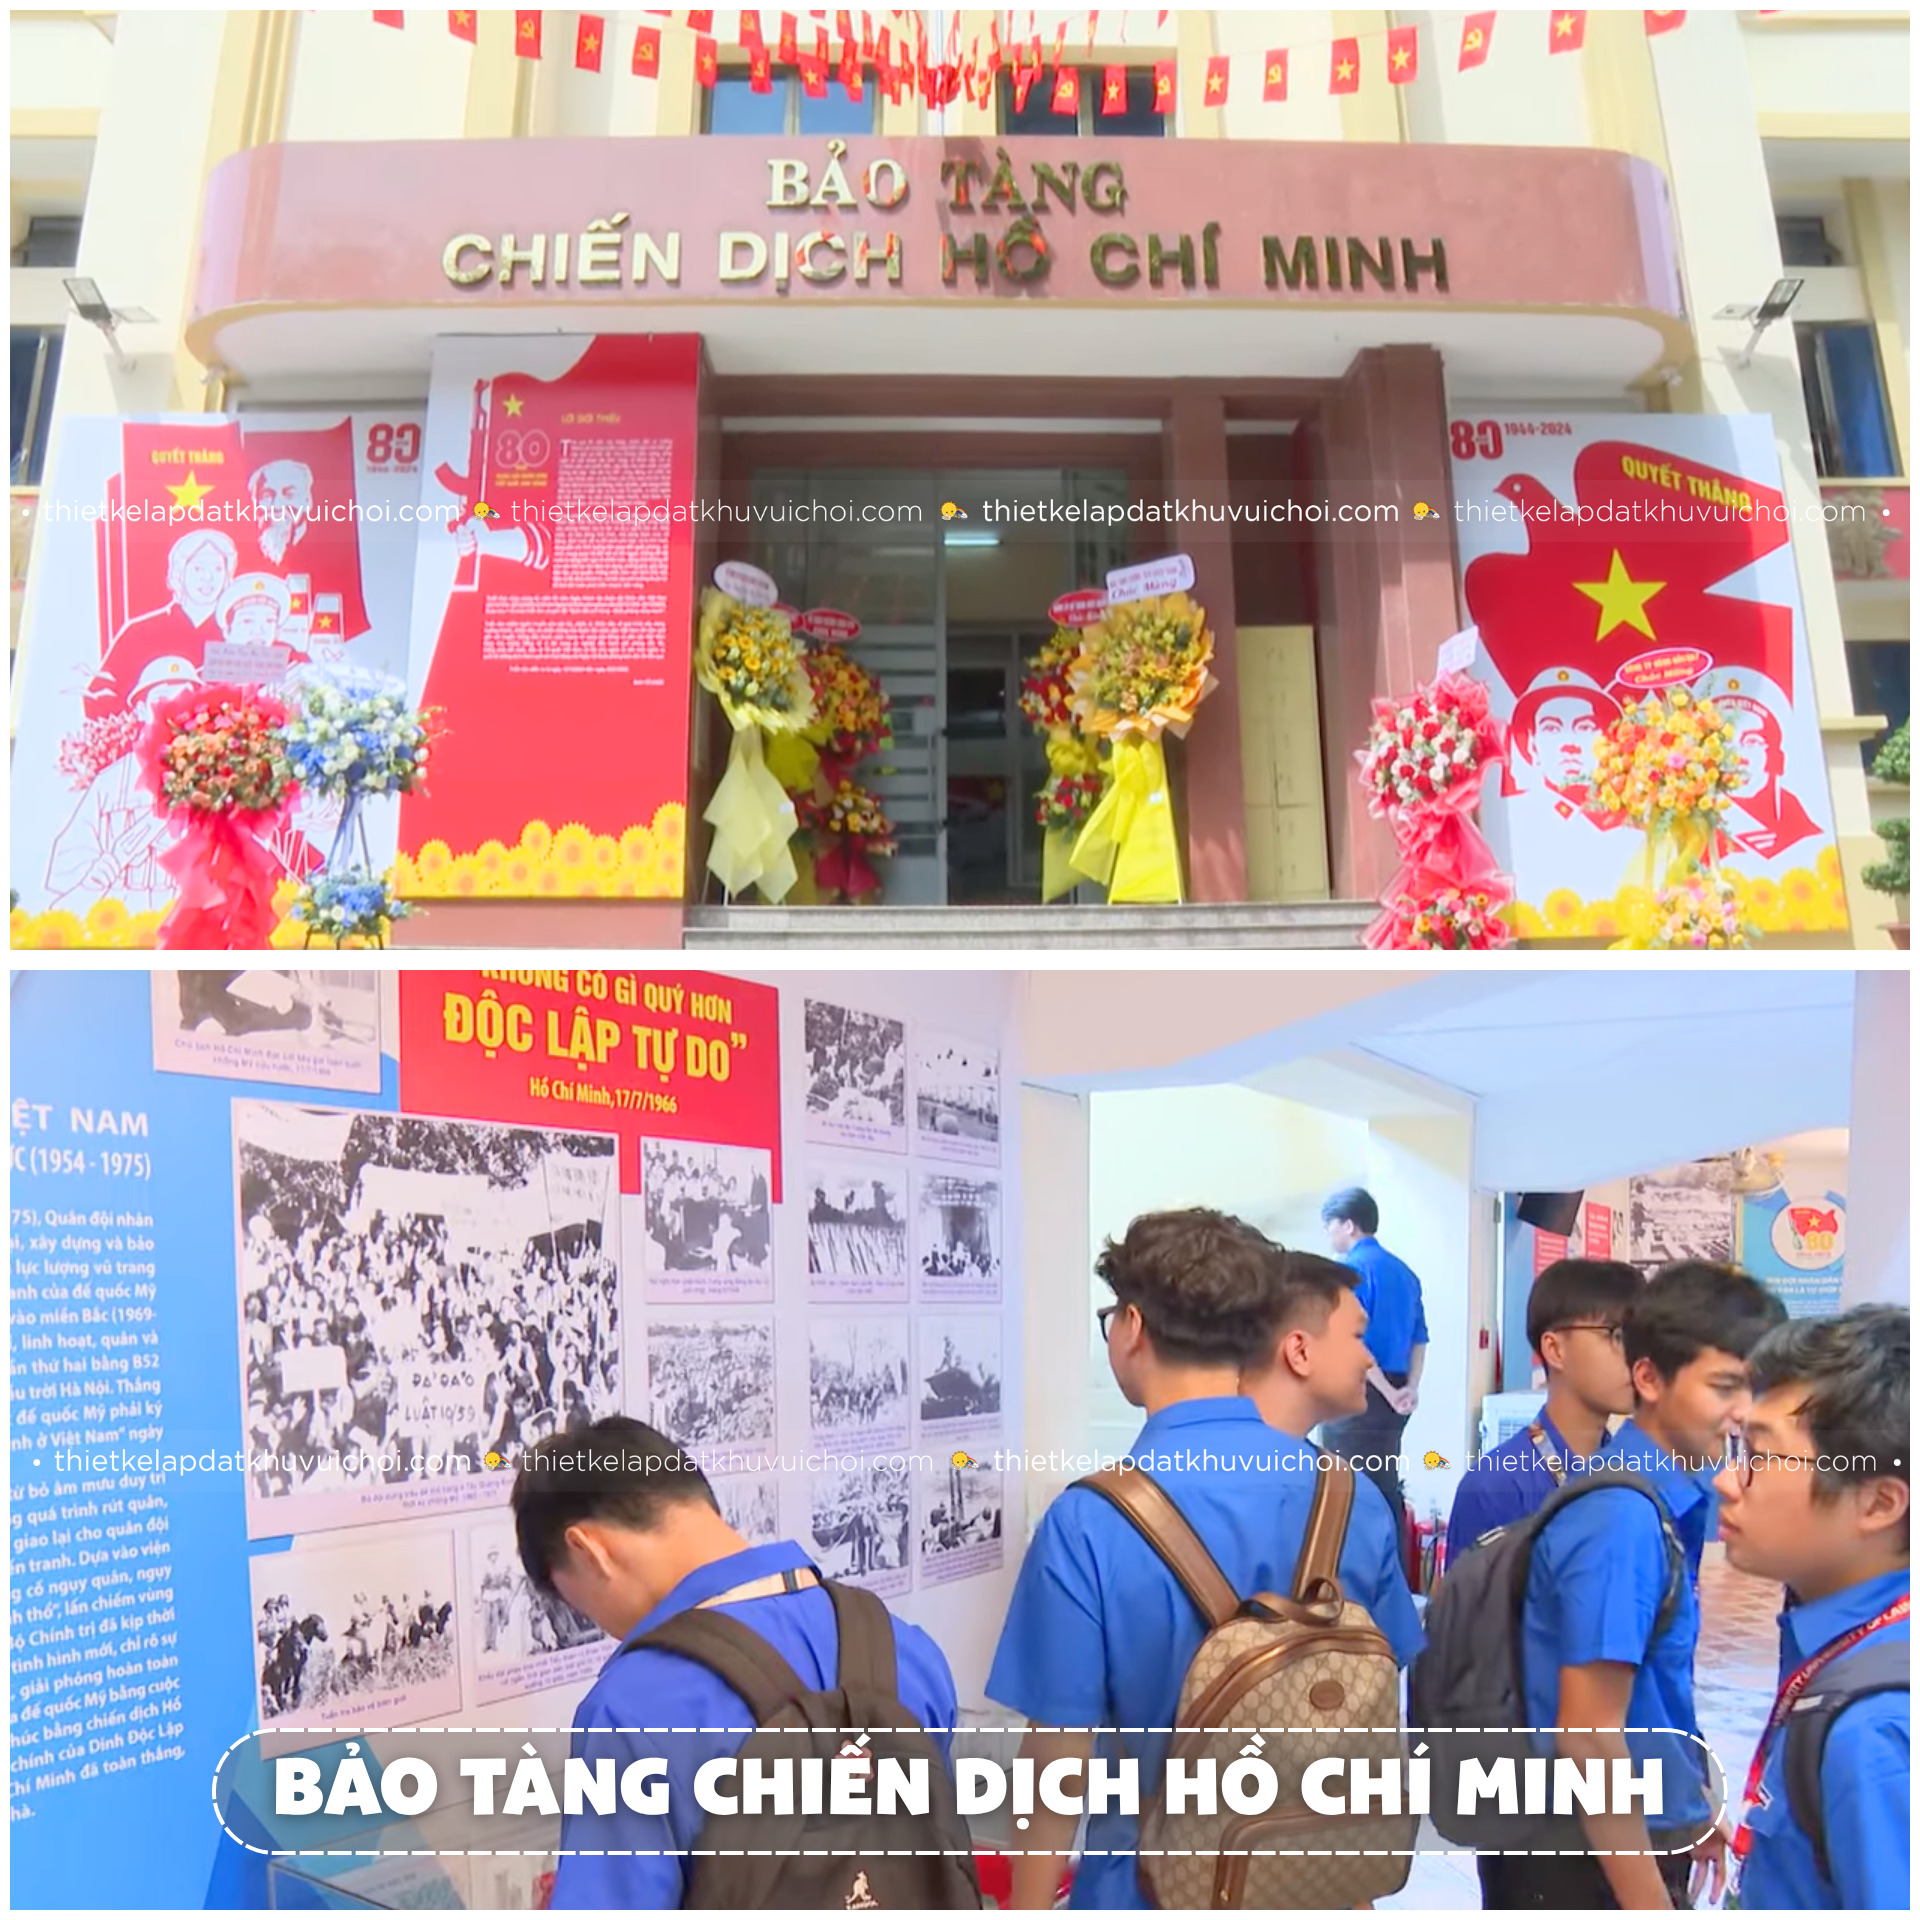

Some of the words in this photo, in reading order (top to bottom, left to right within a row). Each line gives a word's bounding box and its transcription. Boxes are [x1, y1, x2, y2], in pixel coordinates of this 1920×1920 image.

[766, 138, 909, 208] BẢO
[940, 146, 1129, 216] TÀNG
[442, 212, 680, 285] CHIẾN
[719, 231, 901, 293] DỊCH
[940, 213, 1052, 286] HỒ
[1090, 222, 1222, 288] CHÍ
[1261, 235, 1449, 293] MINH
[495, 429, 551, 469] 80
[1450, 420, 1503, 460] 80
[1504, 422, 1572, 436] 1944-2024
[1620, 455, 1681, 491] QUYẾT
[1687, 475, 1752, 513] THẮNG
[615, 974, 637, 1006] GÌ
[644, 983, 684, 1014] QUÝ
[691, 992, 732, 1025] HƠN
[443, 990, 534, 1059] ĐỘC
[548, 1006, 620, 1072] LẬP
[633, 1024, 678, 1082] TỰ
[530, 1076, 550, 1098] Hồ
[552, 1080, 574, 1100] Chí
[70, 1107, 149, 1138] NAM
[29, 1149, 86, 1177] (1954
[101, 1150, 152, 1180] 1975)
[16, 1260, 40, 1279] lực
[44, 1260, 89, 1279] lượng
[117, 1261, 155, 1278] trang
[112, 1308, 156, 1324] (1969-
[22, 1334, 52, 1349] linh
[133, 1355, 160, 1369] B52
[61, 1381, 81, 1397] Hà
[51, 1431, 80, 1449] Việt
[119, 1474, 146, 1490] duy
[103, 1499, 123, 1514] rút
[52, 1530, 71, 1548] lại
[76, 1527, 102, 1542] cho
[30, 1556, 76, 1573] tranh.
[30, 1624, 74, 1646] Chính
[53, 1670, 103, 1693] phóng
[149, 1676, 180, 1694] cuộc
[129, 1705, 159, 1724] dịch
[89, 1736, 124, 1755] Dinh
[159, 1721, 183, 1741] Lập
[36, 1769, 76, 1792] Minh
